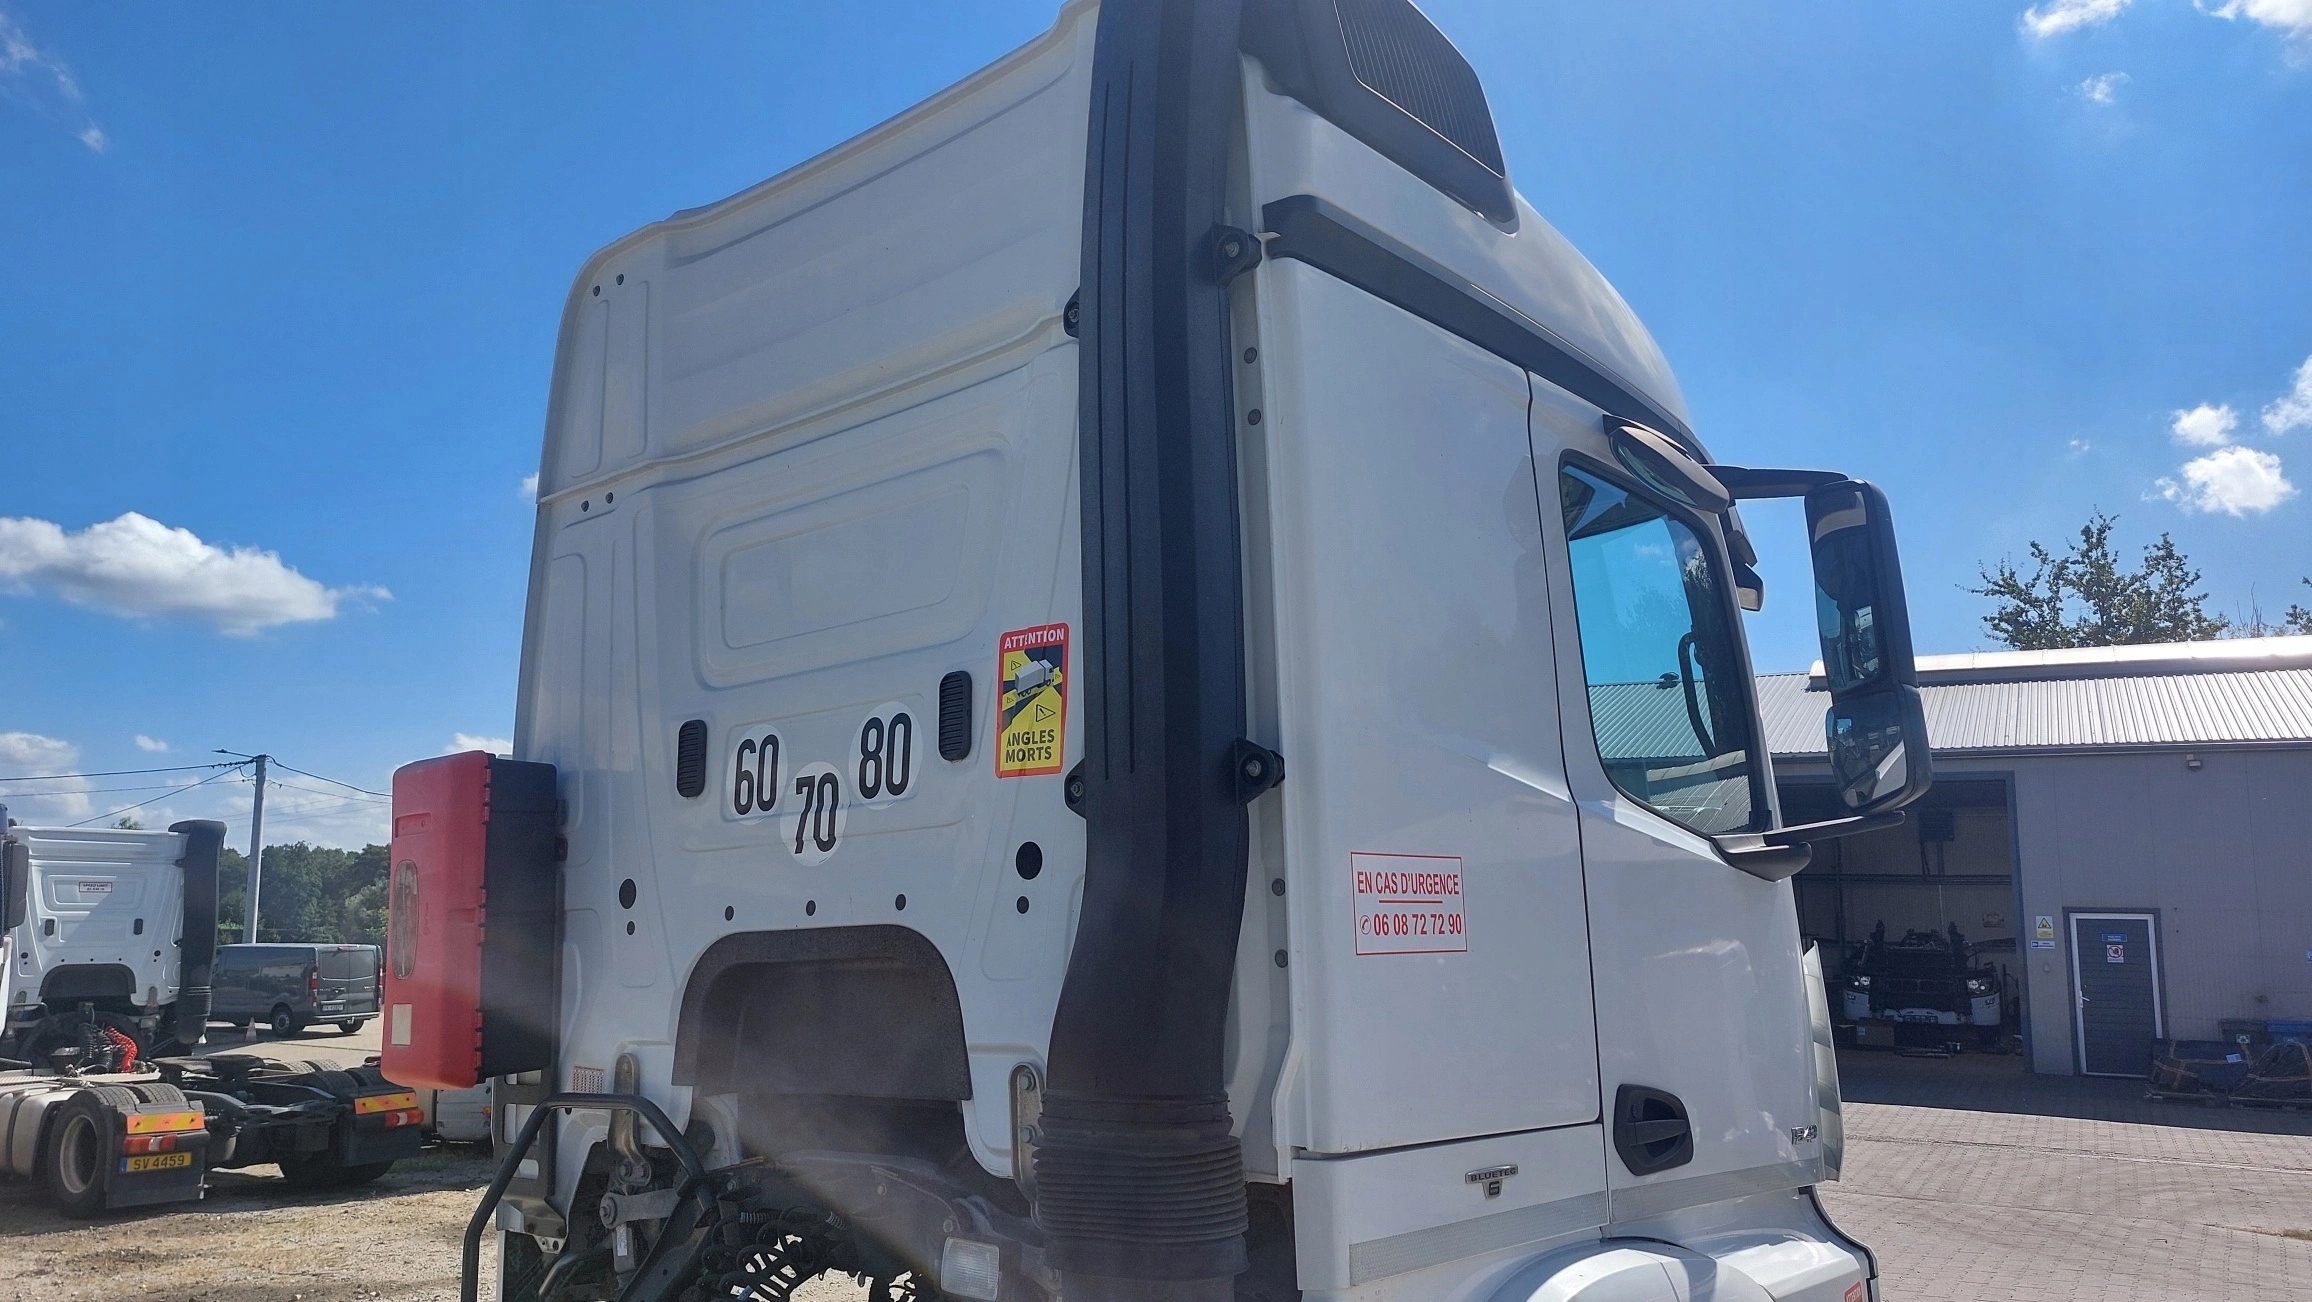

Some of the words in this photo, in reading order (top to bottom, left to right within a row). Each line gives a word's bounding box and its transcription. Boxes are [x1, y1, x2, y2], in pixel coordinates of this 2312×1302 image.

[1004, 628, 1064, 649] ATTENTION
[1006, 729, 1055, 748] ANGLES
[859, 712, 912, 799] 80
[1005, 746, 1052, 763] MORTS
[734, 734, 779, 815] 60
[795, 772, 839, 854] 70
[1357, 871, 1373, 894] EN
[1376, 871, 1398, 894] CAS
[1401, 872, 1460, 895] D'URGENCE
[1374, 913, 1390, 936] 06
[1393, 913, 1409, 936] 08
[1412, 913, 1427, 935] 72
[1430, 913, 1445, 935] 72
[1448, 913, 1462, 935] 90
[133, 1159, 150, 1170] SV
[152, 1155, 185, 1168] 4459
[1470, 1167, 1516, 1182] BLUETEC
[1488, 1180, 1500, 1196] 6
